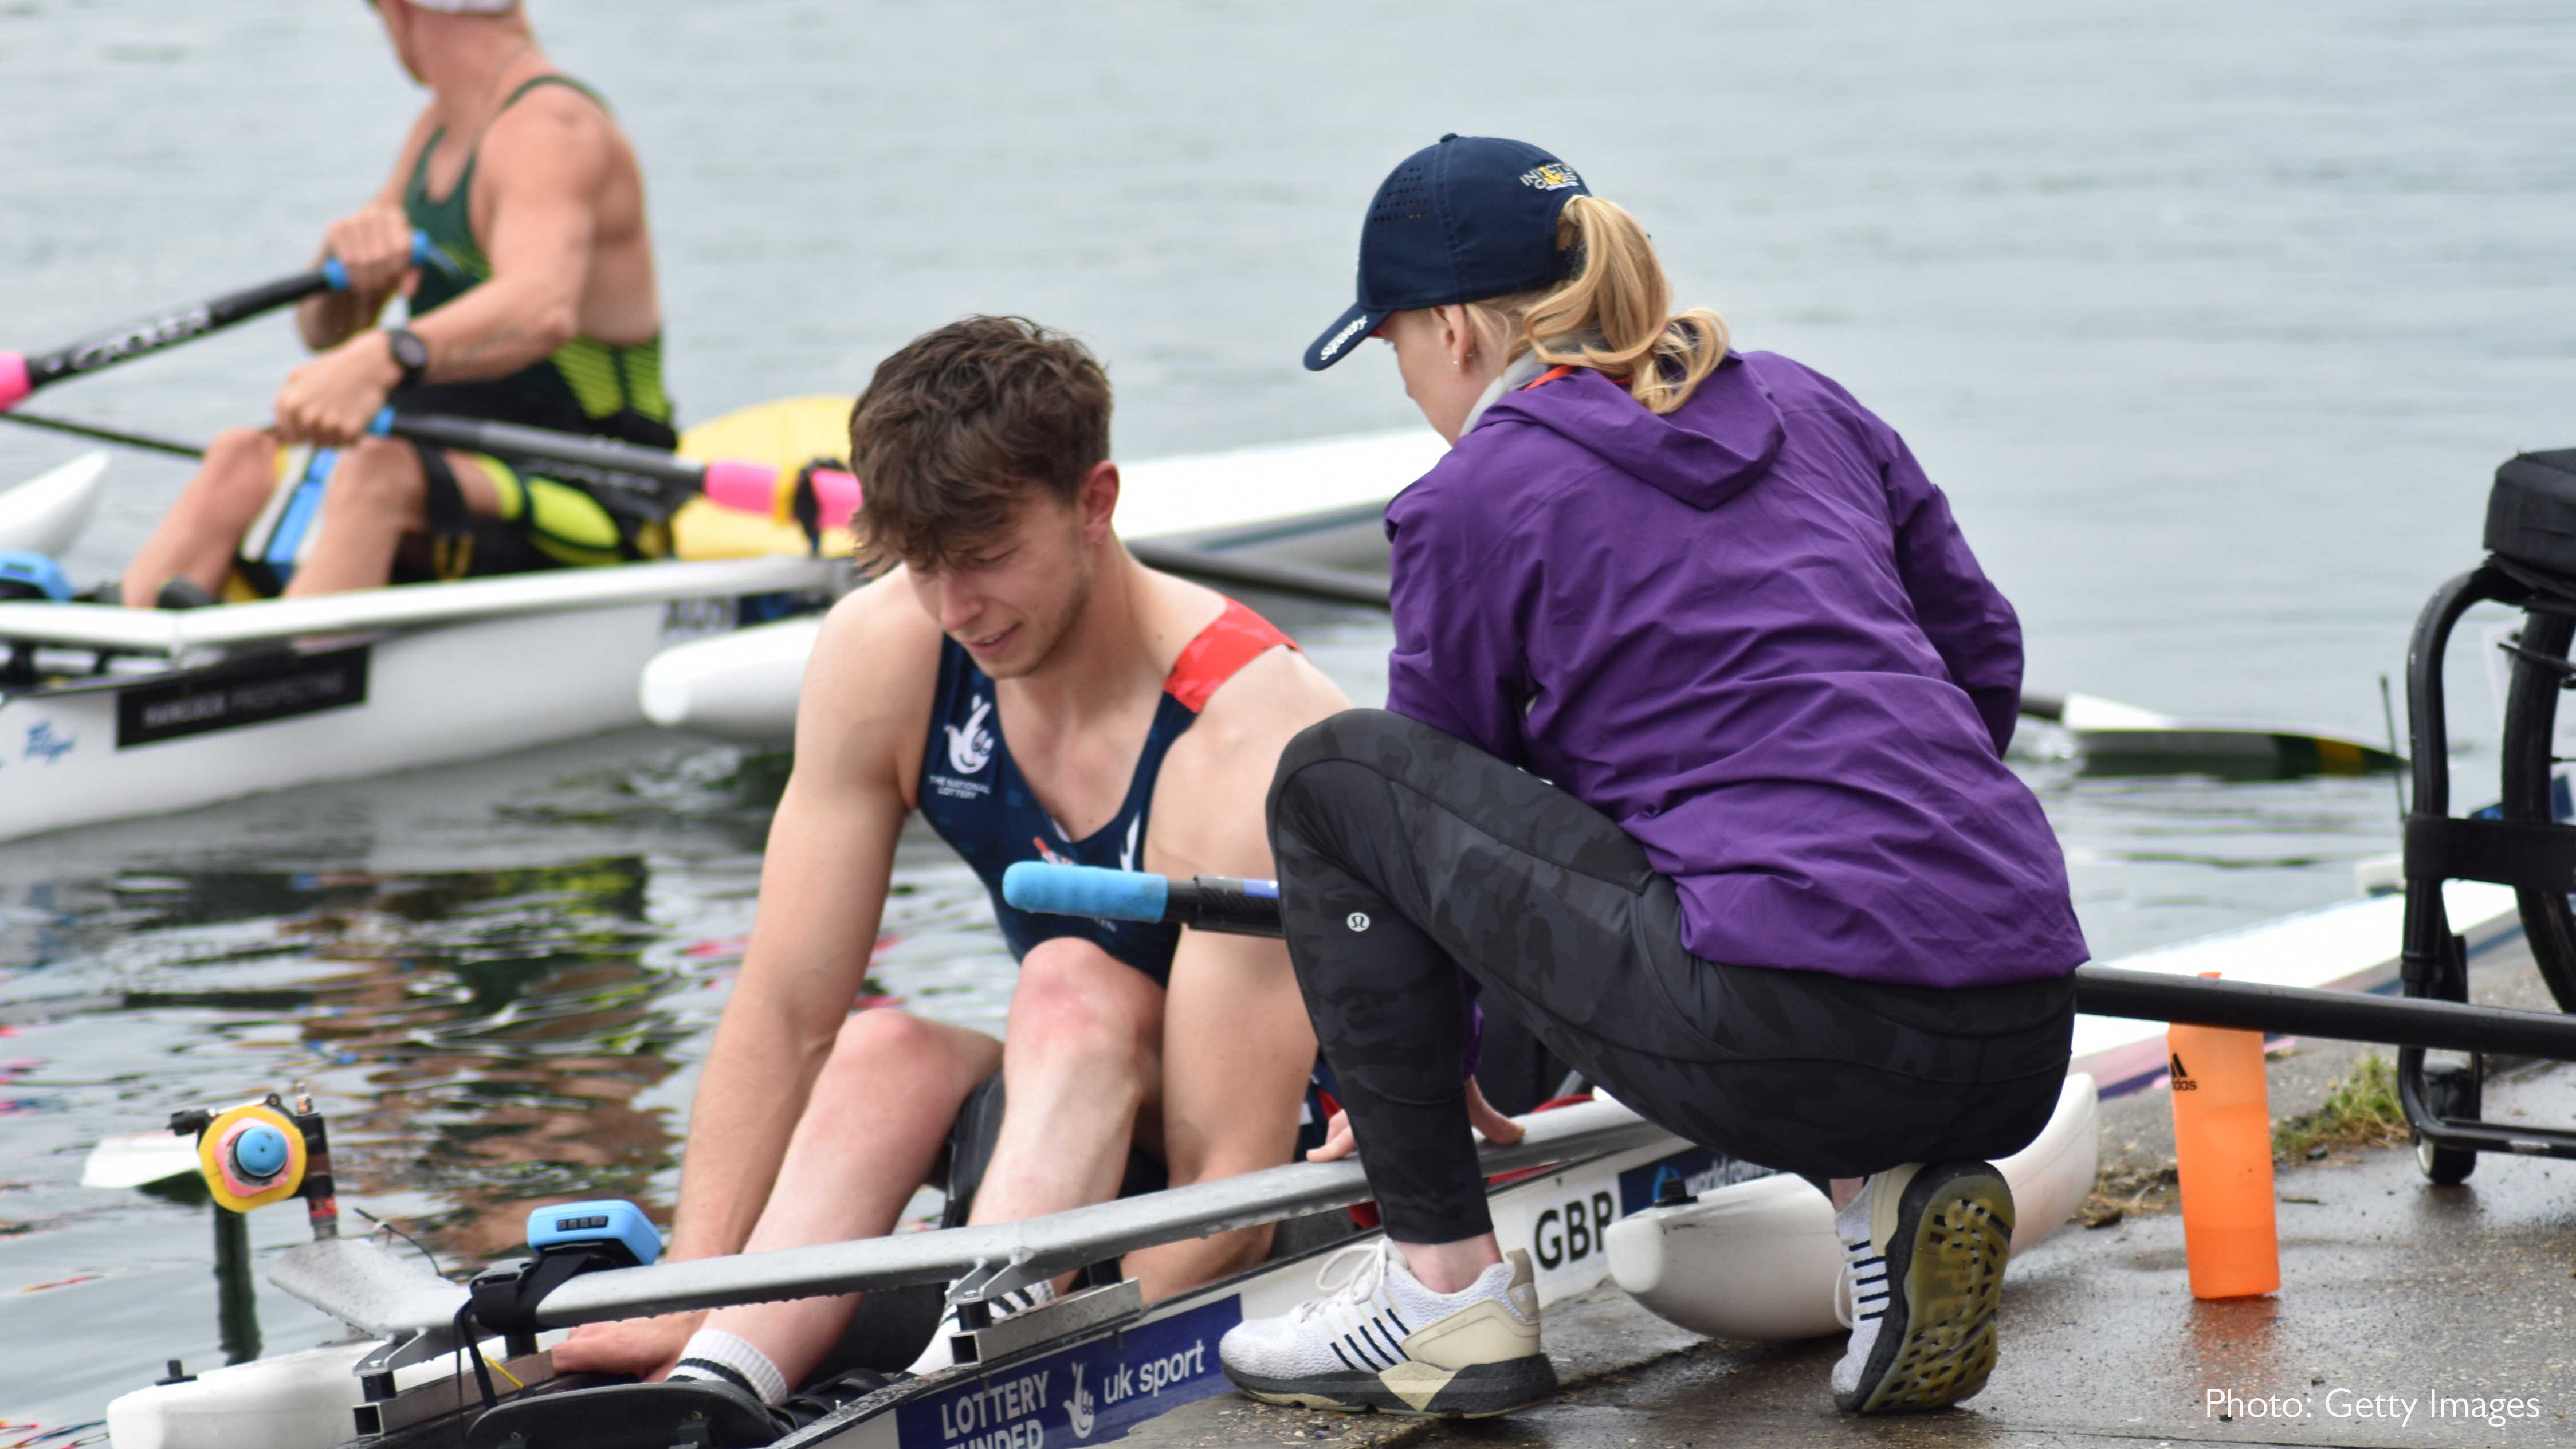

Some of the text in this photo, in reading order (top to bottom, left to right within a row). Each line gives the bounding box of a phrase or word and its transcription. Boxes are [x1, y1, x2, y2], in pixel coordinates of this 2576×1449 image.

[941, 1370, 1050, 1440] LOTTERY
[1104, 1338, 1205, 1404] uk sport
